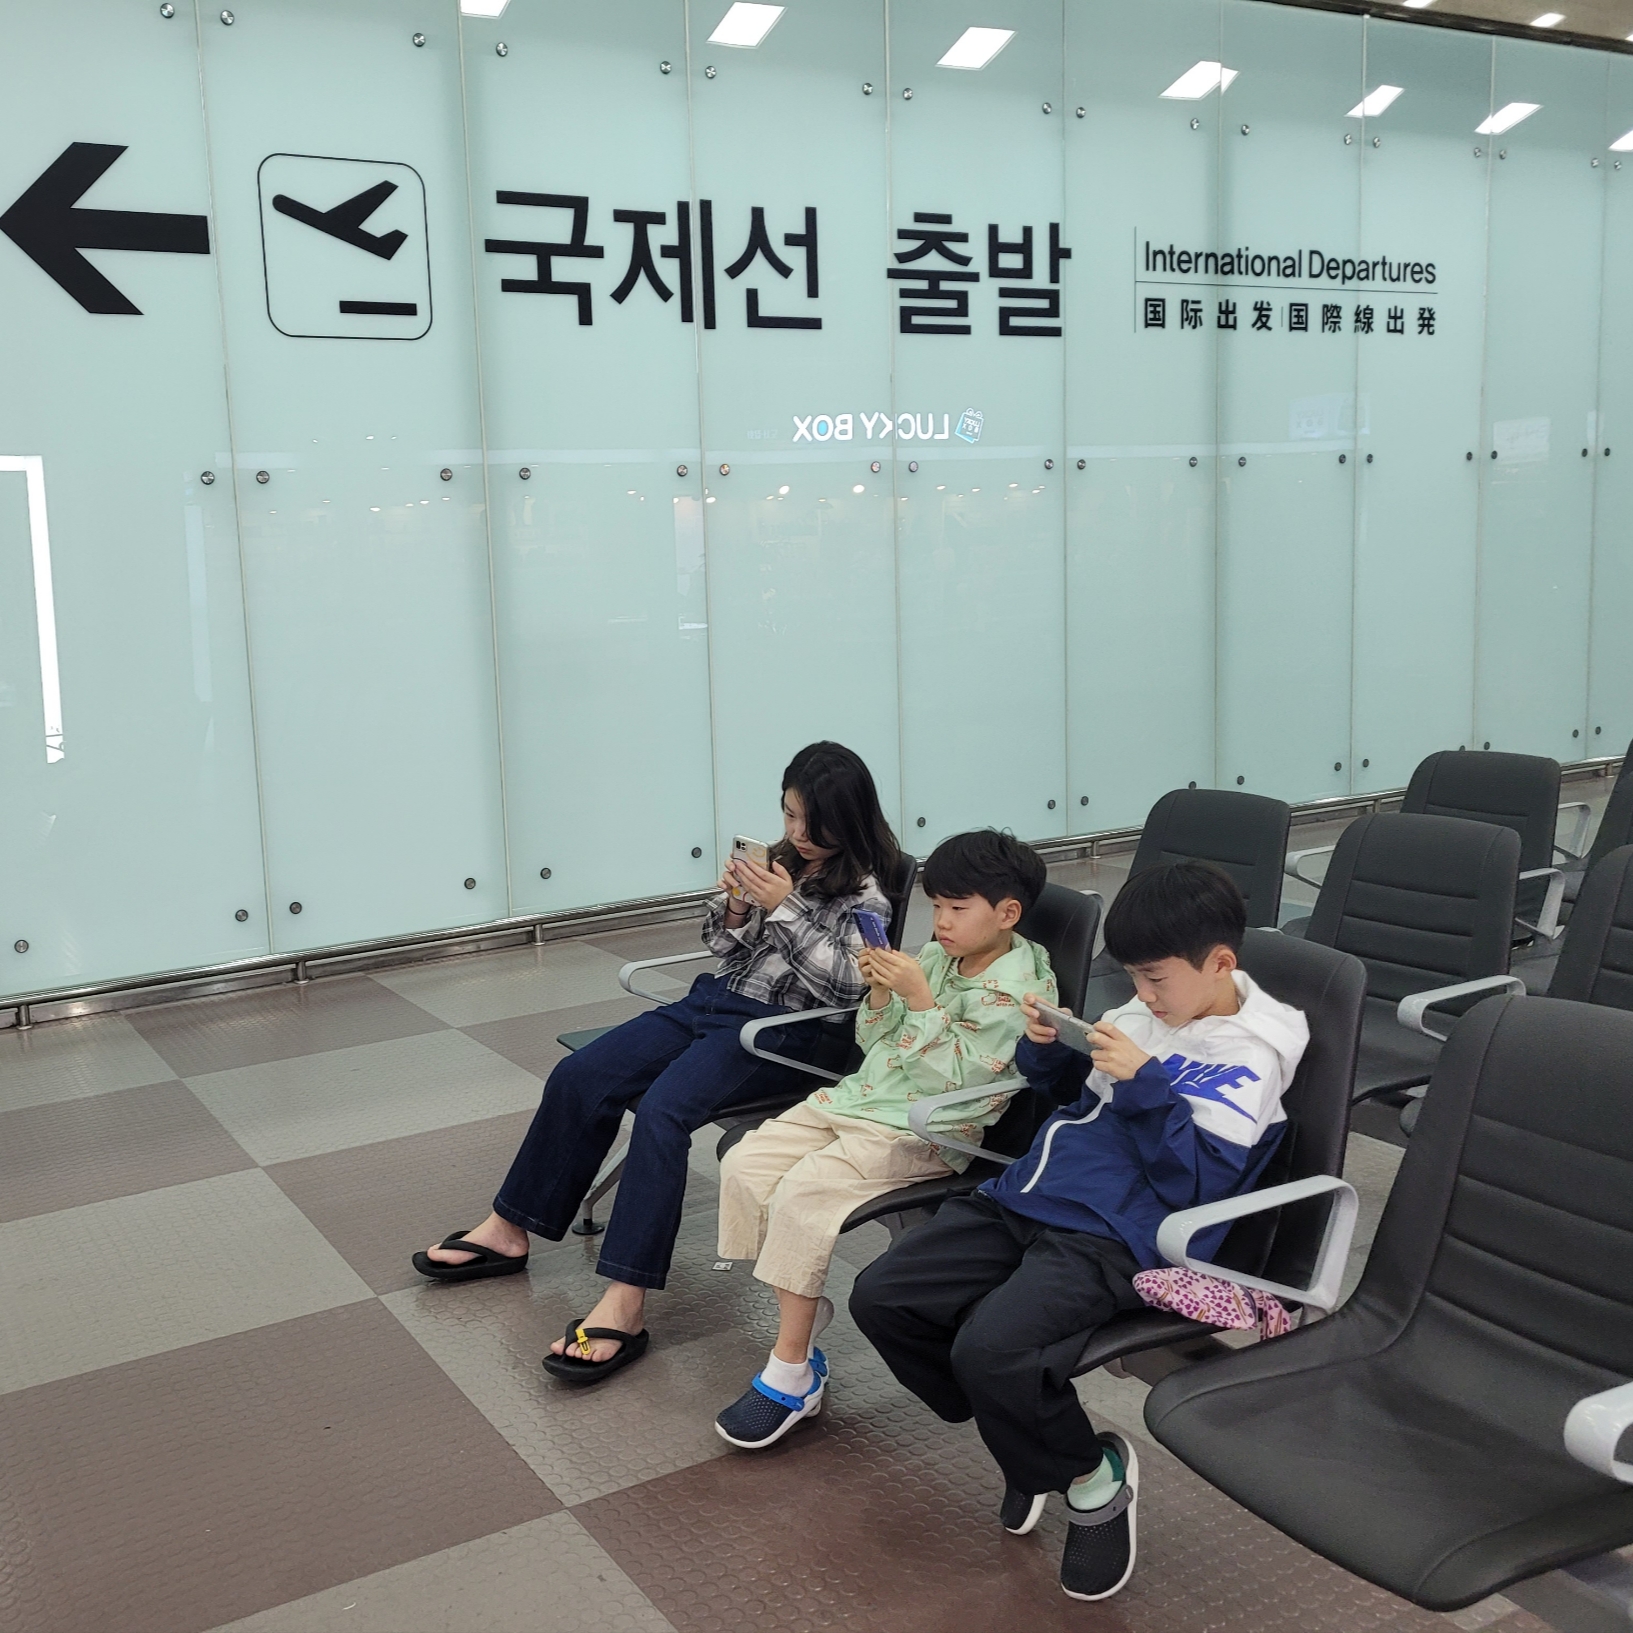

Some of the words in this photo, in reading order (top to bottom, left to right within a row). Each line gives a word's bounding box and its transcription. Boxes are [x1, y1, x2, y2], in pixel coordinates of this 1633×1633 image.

[484, 190, 822, 330] 국제선
[887, 212, 1072, 337] 출발
[1145, 240, 1302, 279] International
[1308, 249, 1436, 285] Departures
[1144, 297, 1273, 332] 国际出发
[1288, 302, 1436, 336] 国際線出発
